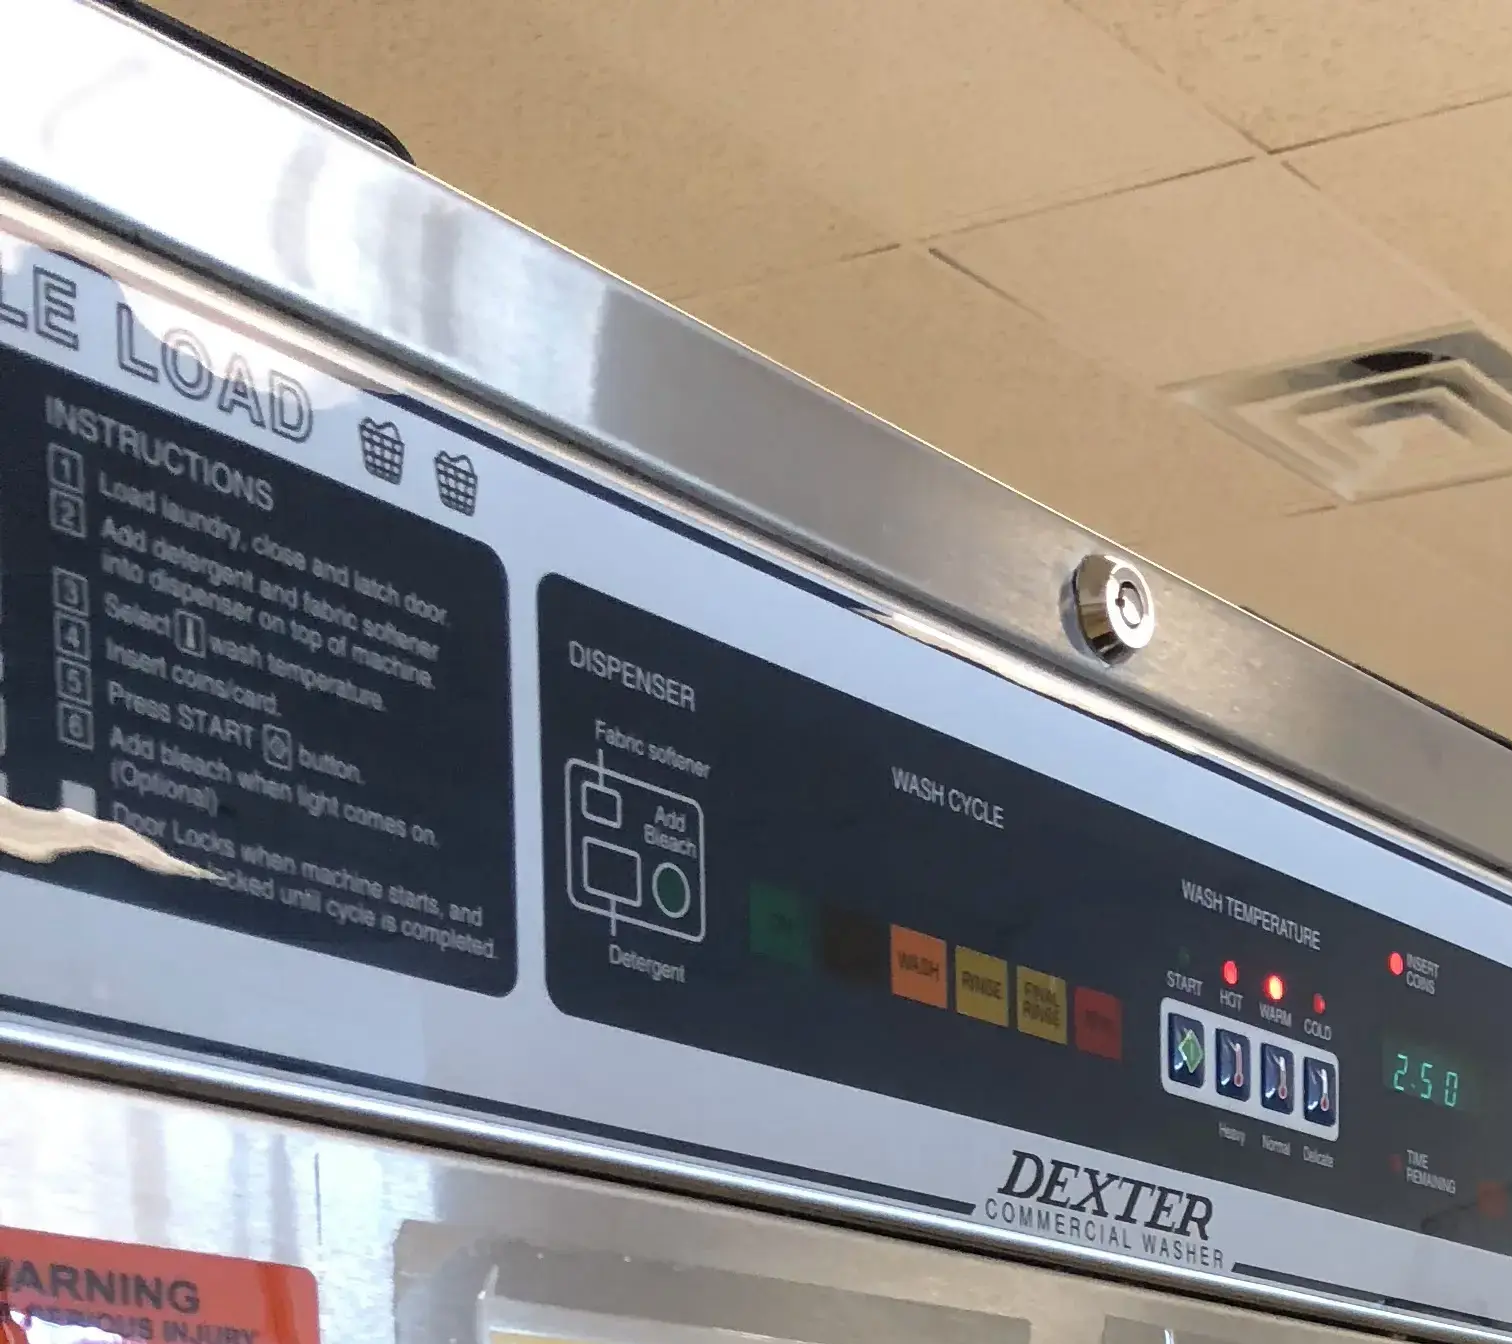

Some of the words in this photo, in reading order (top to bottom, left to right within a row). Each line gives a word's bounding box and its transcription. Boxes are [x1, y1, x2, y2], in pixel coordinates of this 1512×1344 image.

[117, 302, 313, 443] LOAD
[46, 395, 273, 511] INSTRUCTIONS
[106, 637, 168, 680] Insert
[569, 640, 696, 712] DISPENSER
[109, 680, 171, 723] Press
[178, 704, 253, 749] START
[595, 718, 645, 757] Fabric
[648, 742, 711, 779] softener
[110, 725, 154, 760] Add
[161, 744, 232, 783] bleach
[237, 768, 292, 803] when
[297, 785, 339, 818] light
[344, 803, 406, 838] comes
[892, 766, 944, 808] WASH
[948, 788, 1004, 830] CYCLE
[655, 804, 687, 834] Add
[643, 823, 698, 859] Bleach
[1181, 878, 1223, 914] WASH
[1225, 897, 1321, 951] TEMPERATURE
[608, 943, 686, 984] Detergent
[898, 951, 940, 983] WASH
[1406, 953, 1440, 979] INSERT
[961, 970, 1003, 1001] RINSE
[1166, 970, 1204, 997] START
[1219, 989, 1243, 1013] HOT
[1406, 973, 1436, 996] COINS
[1260, 1003, 1292, 1029] WARM
[1304, 1018, 1332, 1042] COLD
[1393, 1053, 1460, 1108] 2.50
[1218, 1121, 1246, 1148] Heavy
[1262, 1135, 1292, 1157] Normal
[1303, 1146, 1334, 1169] Delicate
[1407, 1149, 1430, 1171] TIME
[998, 1149, 1213, 1241] DEXTER
[1406, 1168, 1457, 1196] REMAINING
[985, 1198, 1131, 1250] COMMERCIAL
[1142, 1232, 1224, 1269] WASHER
[0, 1257, 200, 1314] ARNING
